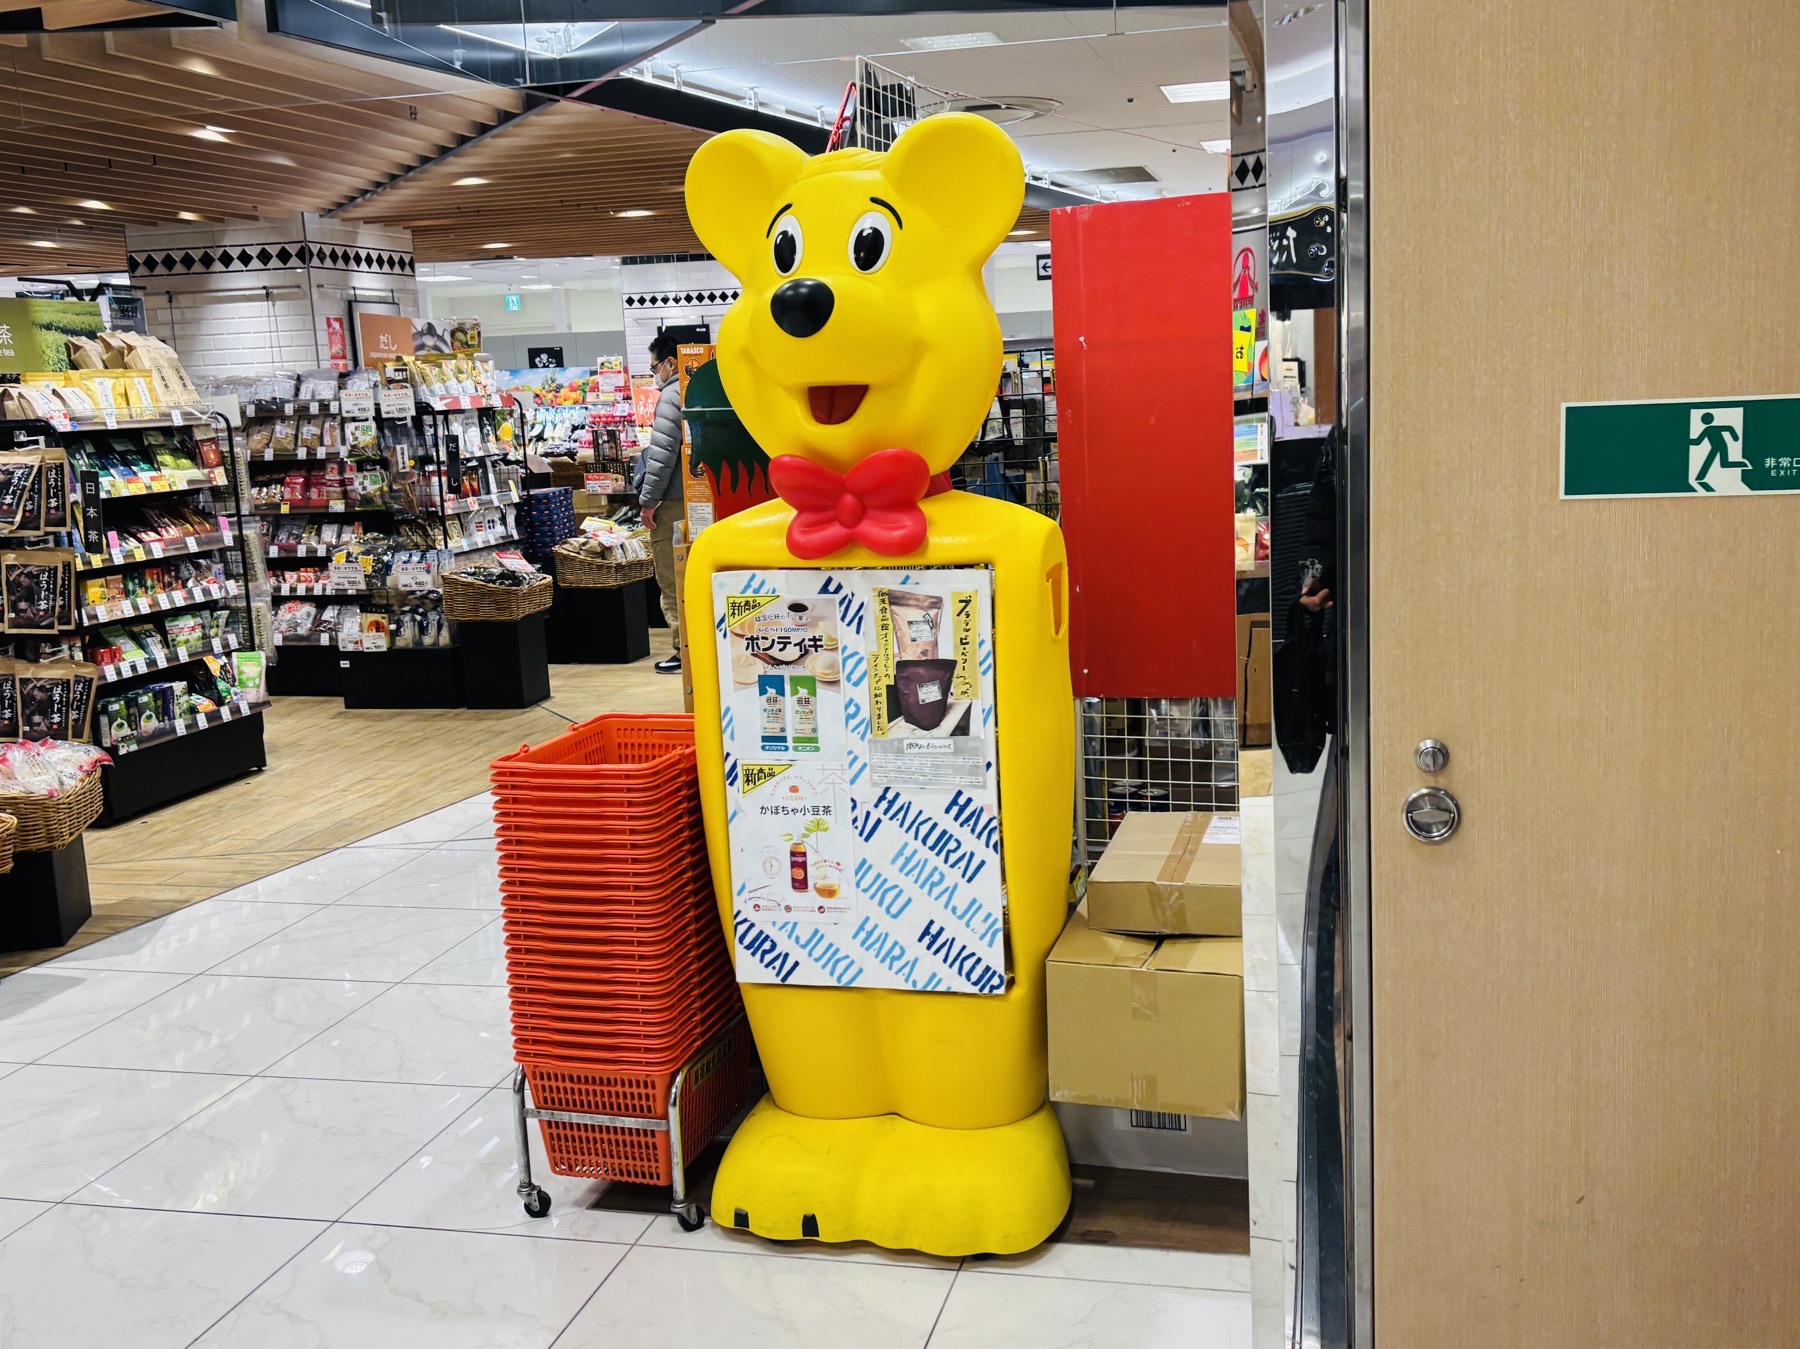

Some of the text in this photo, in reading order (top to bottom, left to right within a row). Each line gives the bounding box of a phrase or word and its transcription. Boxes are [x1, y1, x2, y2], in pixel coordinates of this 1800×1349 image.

[379, 333, 397, 350] だし
[1764, 457, 1800, 468] 非常口
[1770, 469, 1799, 477] EXIT
[2, 469, 23, 505] ほうじ茶
[47, 469, 59, 508] ほうじ茶
[85, 482, 99, 543] 日本茶
[37, 572, 49, 610] ほうじ茶
[730, 599, 761, 619] 新商品
[2, 680, 13, 719] ほうじ茶
[51, 685, 62, 724] ほうじ茶
[744, 767, 776, 786] 新商品
[759, 805, 832, 816] かぼちゃ小豆茶
[873, 787, 986, 884] HAKURAI
[917, 919, 1005, 993] HAKUR
